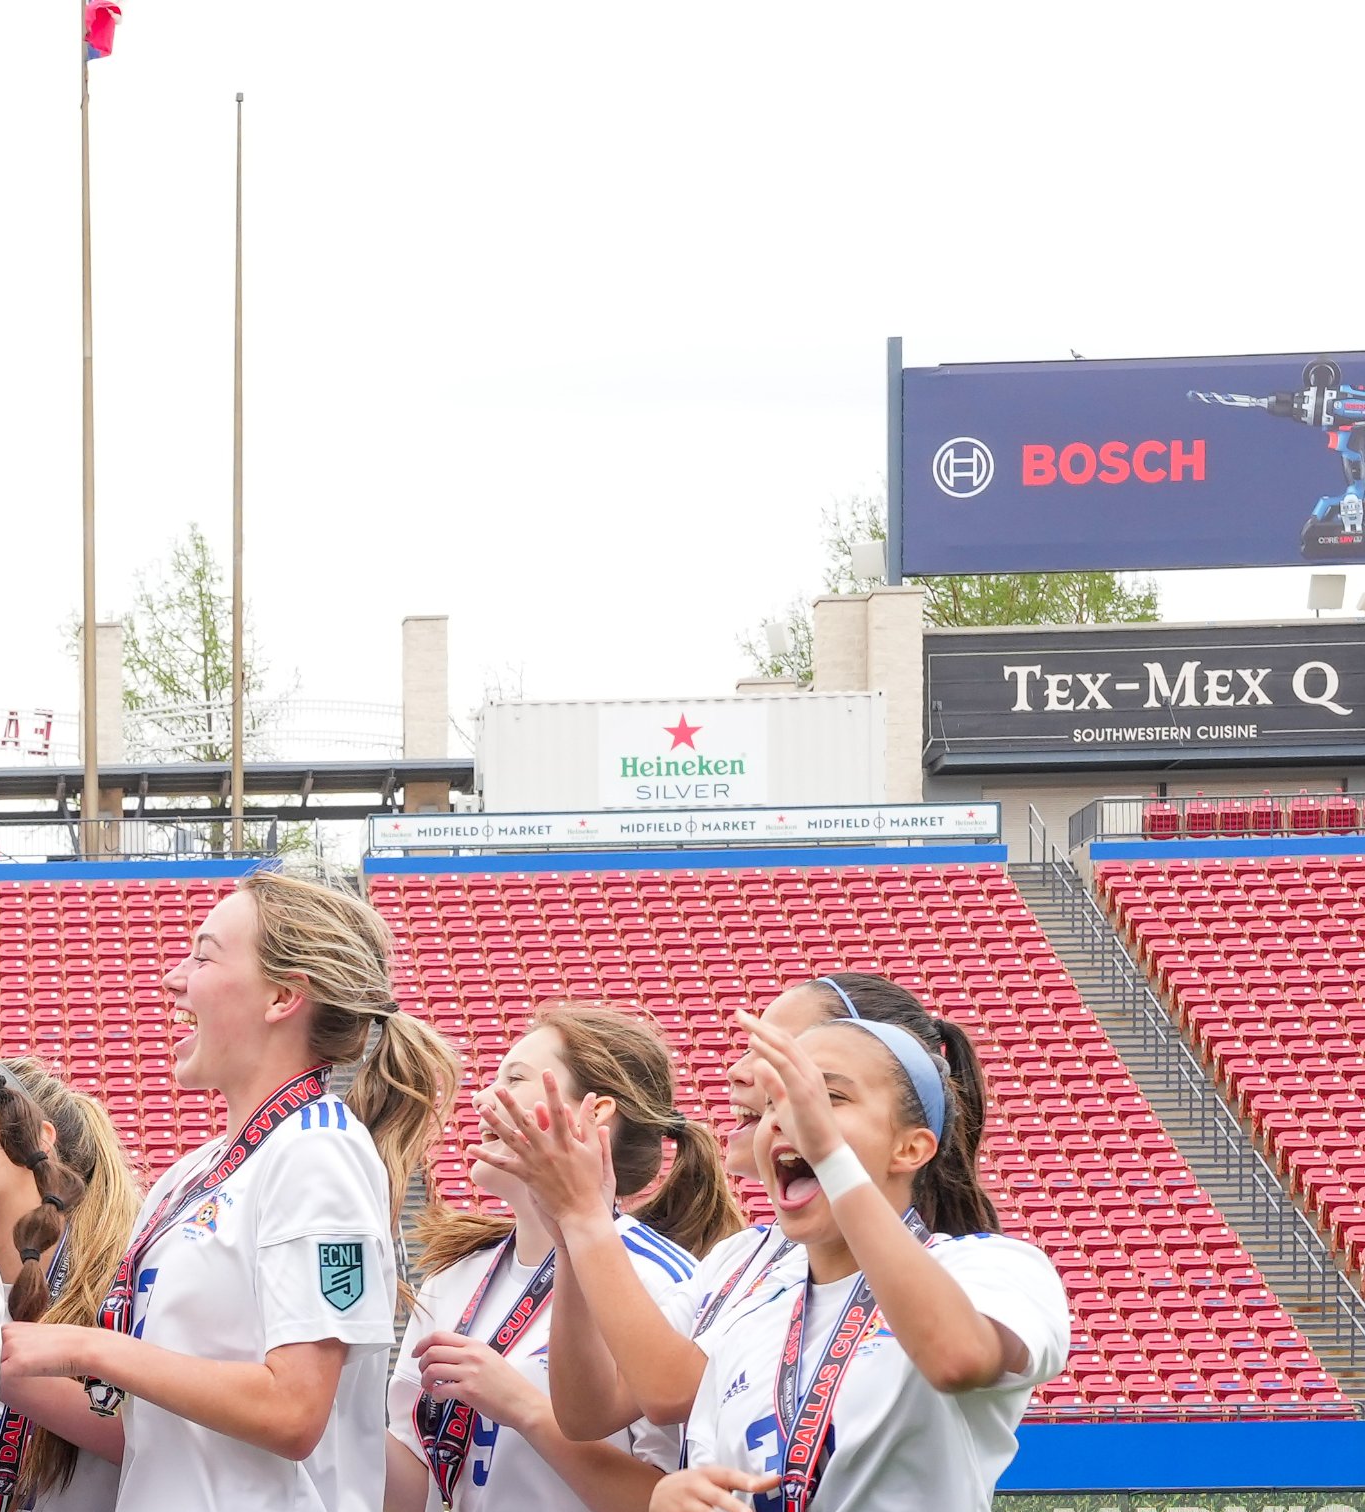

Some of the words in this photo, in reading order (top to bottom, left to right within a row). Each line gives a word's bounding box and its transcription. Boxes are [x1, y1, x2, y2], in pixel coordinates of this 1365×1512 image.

[1022, 440, 1206, 487] BOSCH
[1291, 660, 1354, 716] Q
[1072, 725, 1192, 744] SOUTHWESTERN
[1196, 723, 1258, 740] CUISINE
[620, 754, 745, 779] Heineken
[636, 783, 730, 800] SILVER
[418, 825, 479, 837] MIDFIELD
[498, 824, 553, 836] MARKET
[620, 821, 683, 833] MIDFIELD
[701, 820, 757, 832] MARKET
[807, 818, 870, 830] MIDFIELD
[890, 816, 945, 828] MARKET
[246, 1074, 321, 1145] DALLAS
[203, 1146, 247, 1190] CUP
[321, 1245, 361, 1266] ECNL
[497, 1295, 534, 1346] CUP
[788, 1364, 838, 1465] DALLAS
[830, 1305, 866, 1359] CUP
